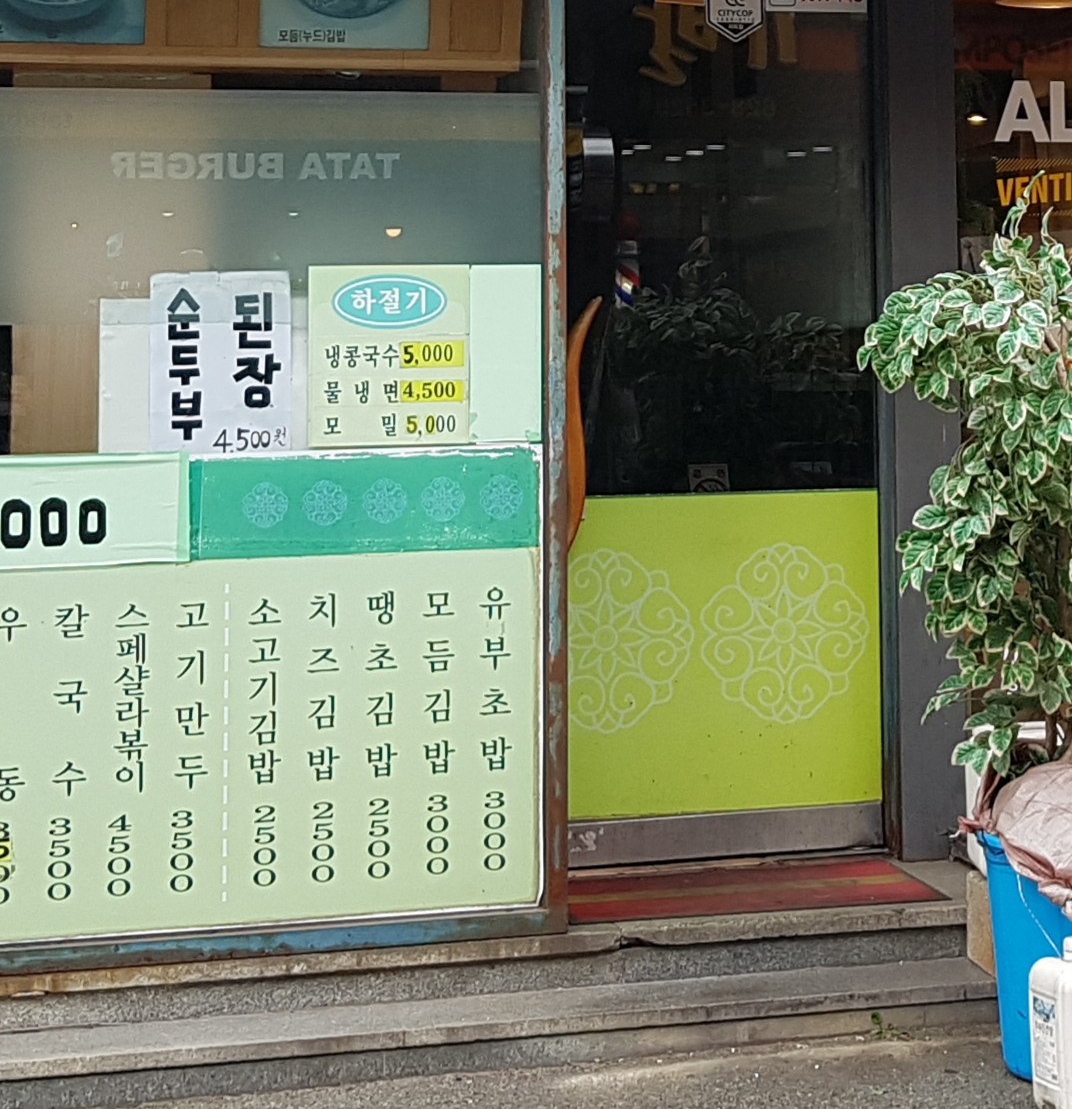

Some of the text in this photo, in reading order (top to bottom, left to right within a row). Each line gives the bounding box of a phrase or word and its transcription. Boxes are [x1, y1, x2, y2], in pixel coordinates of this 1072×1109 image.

[717, 9, 754, 18] CITYCOP
[166, 287, 203, 441] 순두부
[232, 291, 282, 409] 된장
[325, 343, 454, 369] 냉콩국수 5,000
[350, 287, 430, 315] 하절기
[402, 381, 456, 402] 4,500
[406, 414, 457, 440] 5,000
[107, 603, 150, 897] 스페샬라볶이 4500
[169, 602, 210, 893] 고기만두 3500
[247, 598, 282, 887] 소고기김밥 2500
[306, 592, 340, 883] 치즈김밥 2500
[364, 590, 398, 879] 땡초김밥 2500
[422, 592, 456, 875] 모듬김밥 3000
[478, 587, 513, 871] 유부초밥 3000
[47, 817, 72, 901] 3500
